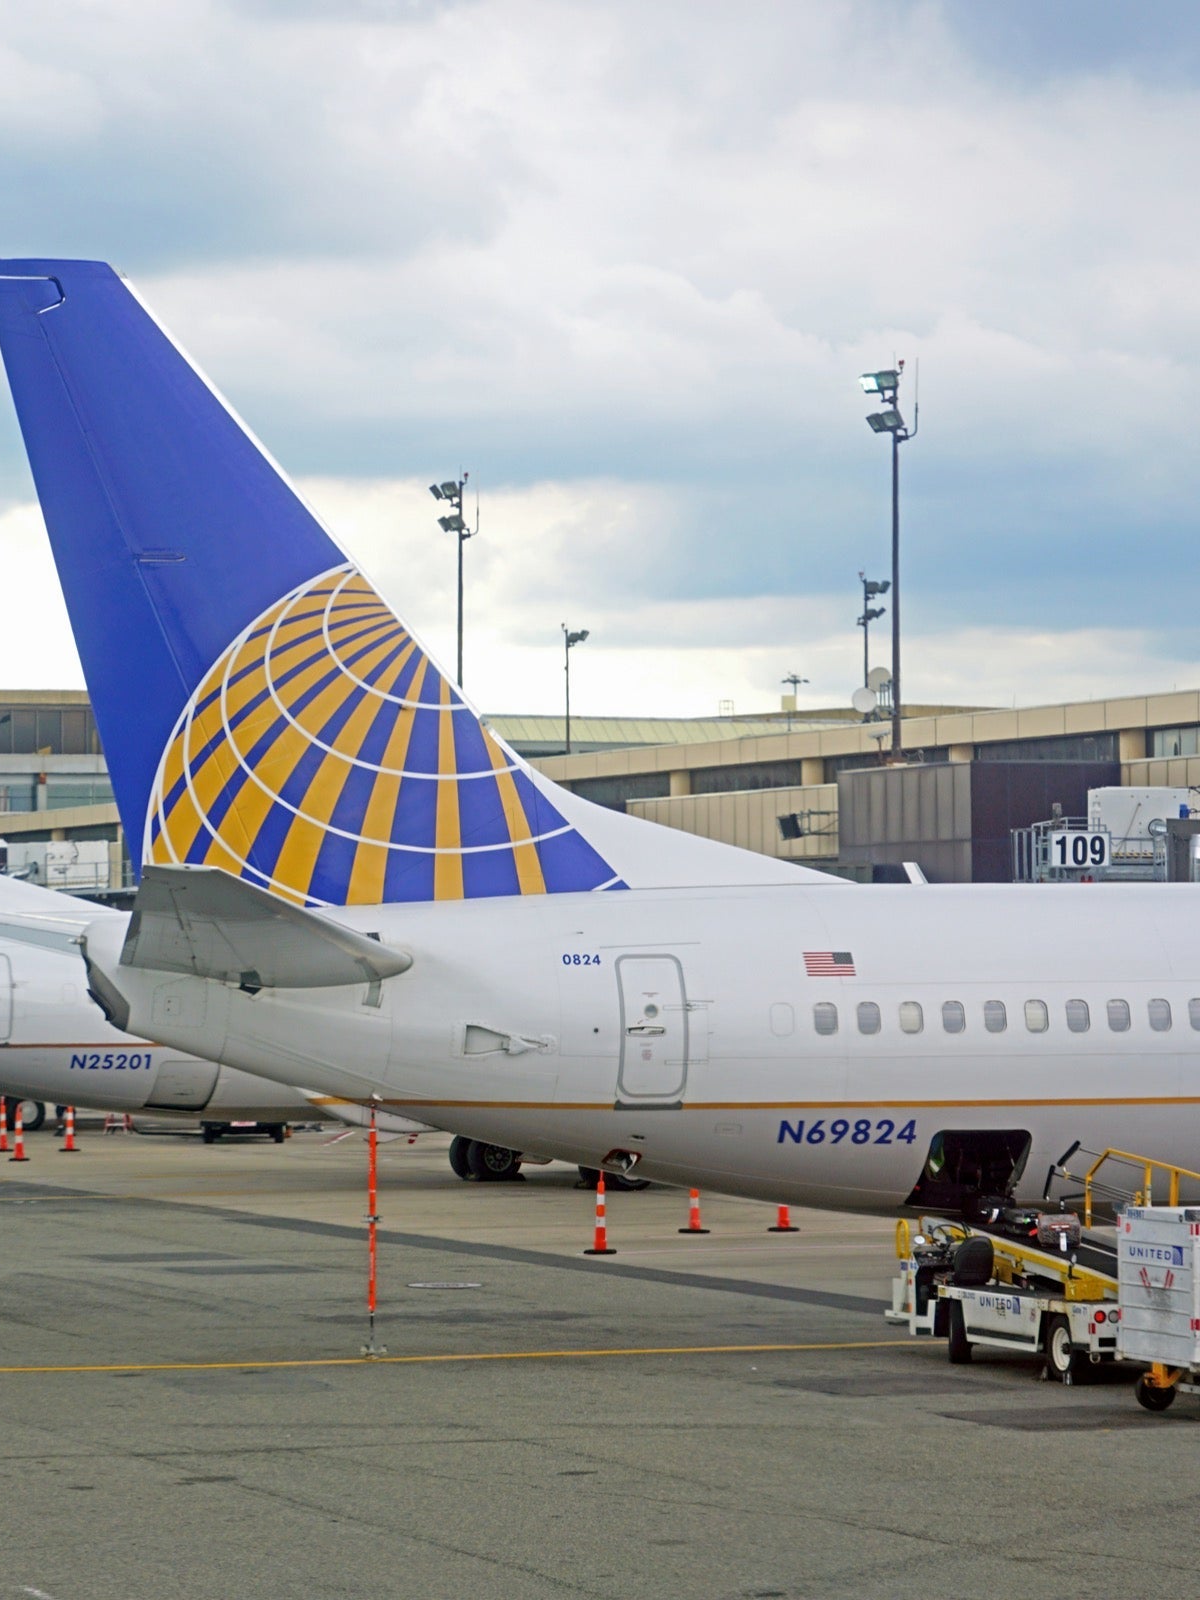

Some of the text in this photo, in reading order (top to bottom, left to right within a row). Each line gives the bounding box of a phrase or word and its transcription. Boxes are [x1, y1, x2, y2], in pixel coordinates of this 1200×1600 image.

[1055, 835, 1106, 866] 109
[562, 954, 601, 966] 0824
[70, 1053, 153, 1070] N25201
[777, 1119, 917, 1145] N69824
[1129, 1246, 1172, 1261] UNITED
[980, 1296, 1012, 1310] UNITED
